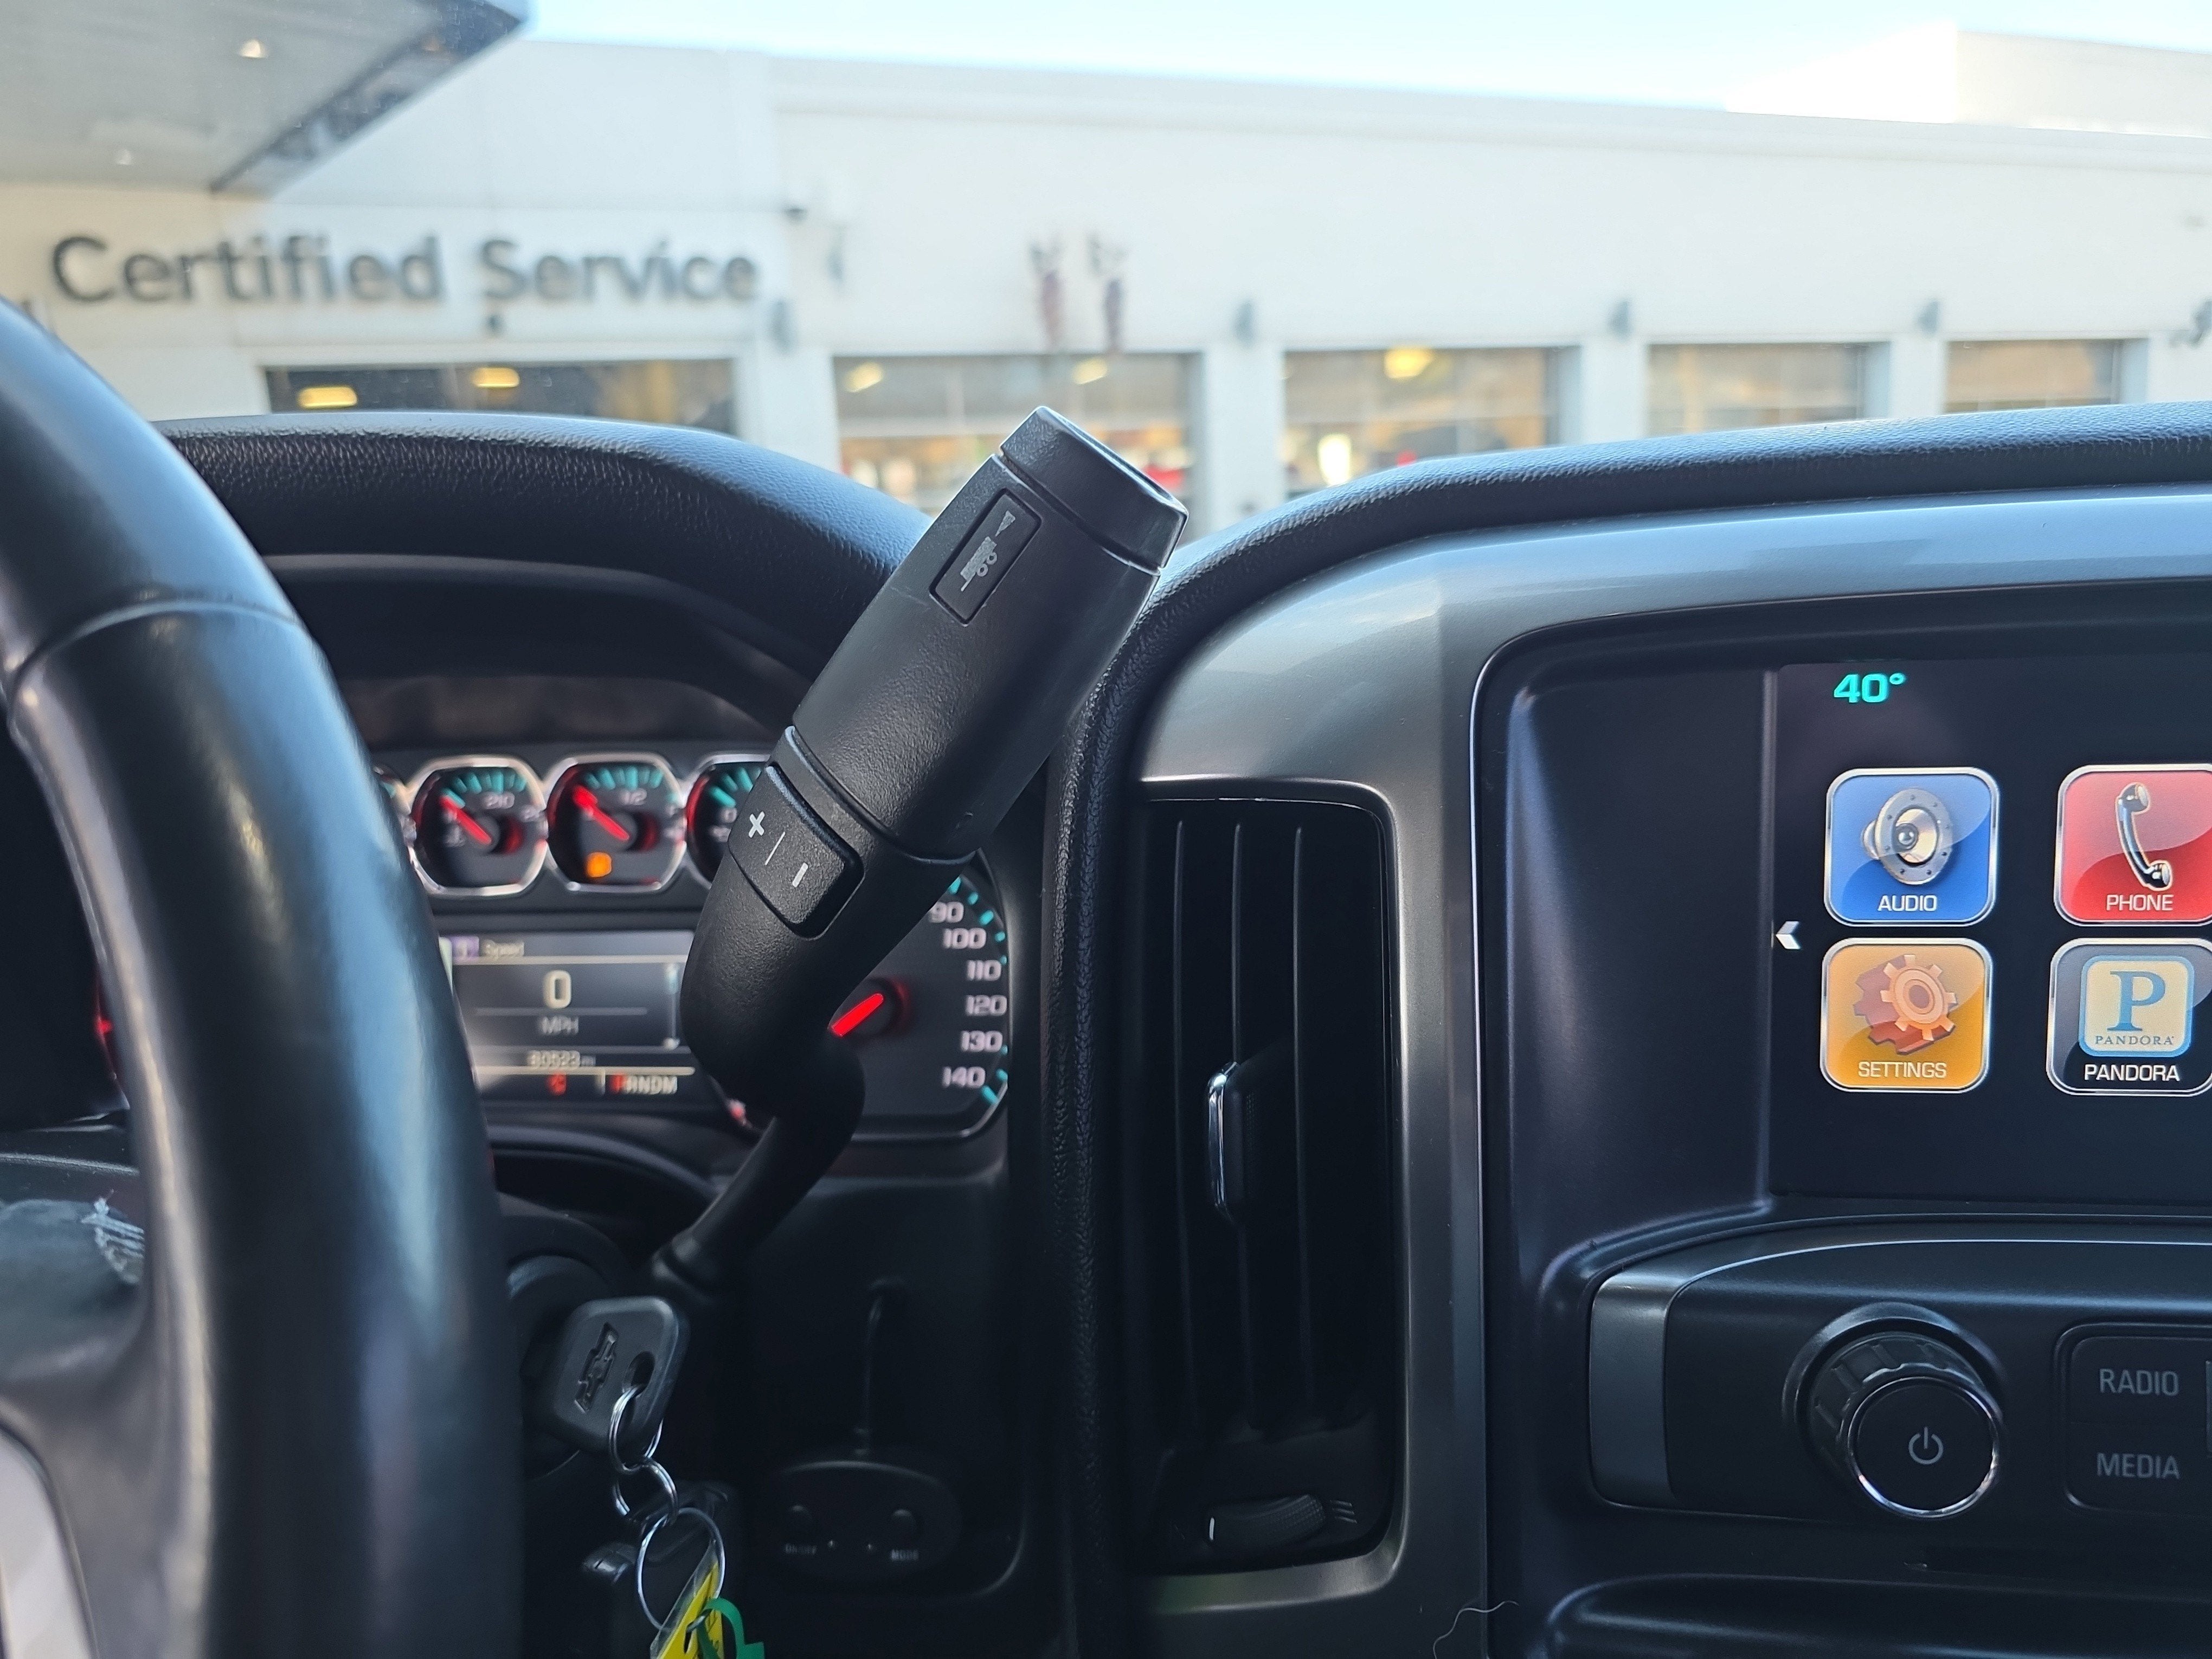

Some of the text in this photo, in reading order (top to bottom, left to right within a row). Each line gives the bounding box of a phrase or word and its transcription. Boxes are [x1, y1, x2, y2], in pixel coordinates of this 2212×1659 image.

[52, 233, 759, 304] Certified Service
[1833, 672, 1907, 704] 40°
[928, 902, 964, 922] 90
[1877, 895, 1938, 912] AUDIO
[2106, 894, 2175, 912] PHONE
[942, 928, 987, 949] 100
[967, 960, 1002, 981] 110
[965, 995, 1007, 1017] 120
[961, 1030, 1003, 1052] 130
[2095, 1036, 2174, 1045] PANDORA
[941, 1066, 986, 1088] 140
[1857, 1061, 1947, 1079] SETTINGS
[2084, 1064, 2181, 1082] PANDORA
[2099, 1368, 2179, 1397] RADIO
[2097, 1453, 2181, 1480] MEDIA
